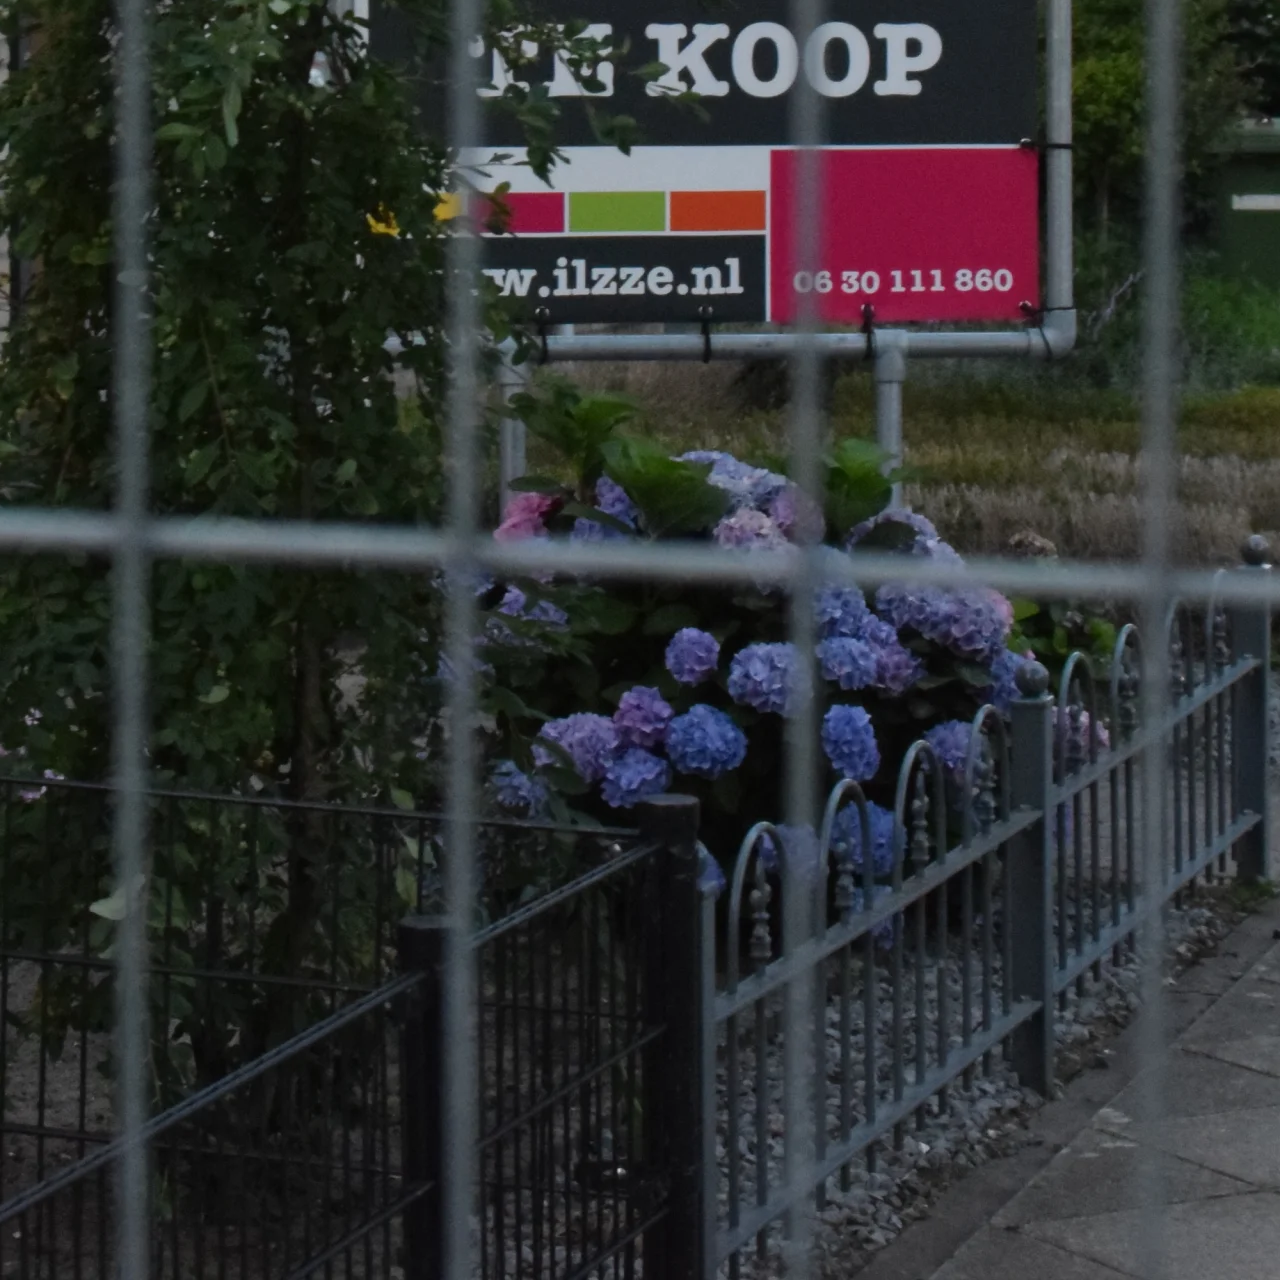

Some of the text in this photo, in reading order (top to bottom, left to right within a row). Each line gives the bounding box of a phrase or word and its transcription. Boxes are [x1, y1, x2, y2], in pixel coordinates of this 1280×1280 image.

[645, 20, 943, 98] KOOP
[432, 257, 745, 298] w.ilzze.nl
[793, 268, 1014, 294] 06 30 111 860
